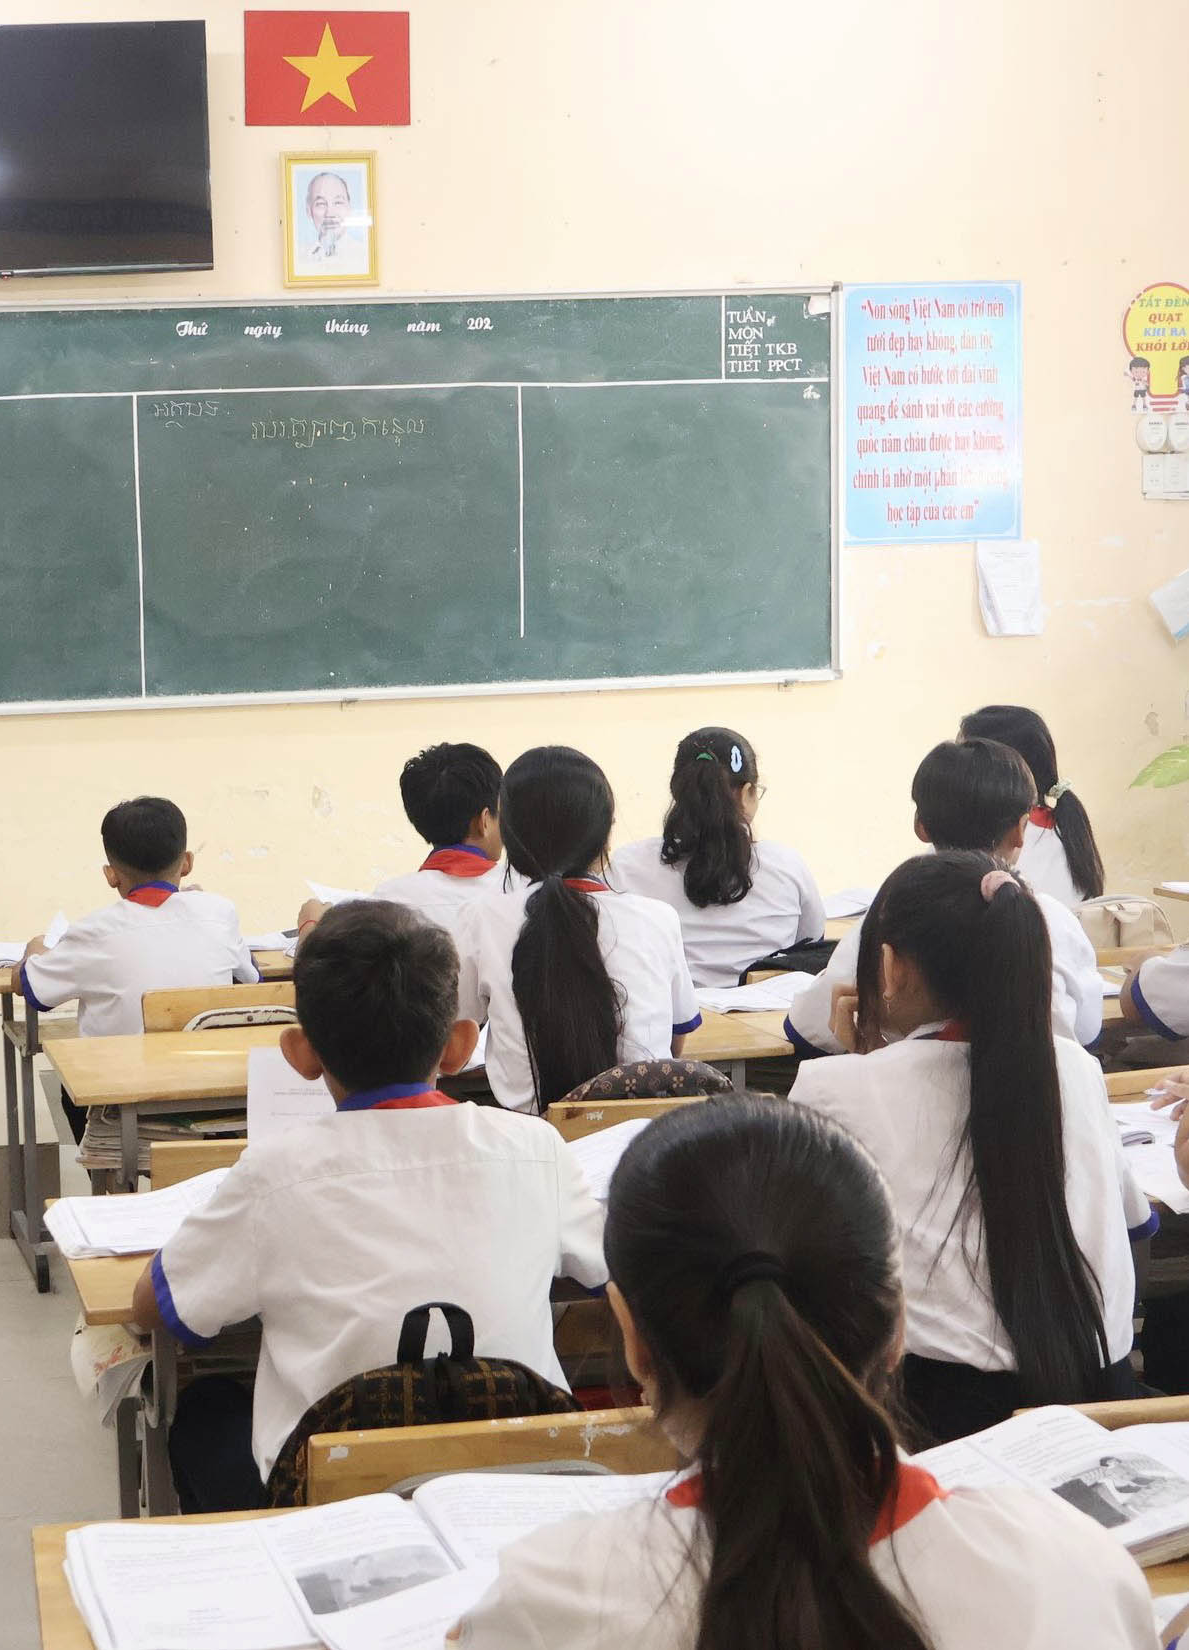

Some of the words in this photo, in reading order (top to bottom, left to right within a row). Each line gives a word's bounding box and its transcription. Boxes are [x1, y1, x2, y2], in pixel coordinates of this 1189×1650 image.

[727, 305, 766, 323] TUẦN
[913, 298, 931, 325] Việt
[935, 299, 956, 318] Nam
[958, 298, 969, 317] có
[1148, 313, 1183, 325] QUẠT
[175, 320, 208, 336] Thứ
[244, 321, 282, 339] ngày
[325, 319, 370, 337] tháng
[467, 317, 494, 330] 202
[728, 325, 764, 340] MÔN
[1144, 327, 1166, 336] KHI
[1171, 327, 1187, 336] RA
[728, 338, 761, 356] TIẾT
[765, 343, 798, 355] TKB
[889, 331, 905, 358] đẹp
[908, 331, 924, 356] hay
[767, 358, 803, 372] PPCT
[863, 366, 881, 392] Việt
[885, 366, 905, 386] Nam
[908, 364, 919, 385] có
[857, 403, 885, 425] quang
[902, 398, 923, 419] sánh
[926, 398, 939, 418] vai
[857, 428, 879, 459] quốc
[929, 431, 953, 458] được
[853, 466, 879, 488] chính
[883, 466, 891, 488] là
[914, 466, 931, 494] một
[887, 501, 903, 528] học
[906, 500, 920, 527] tập
[923, 498, 939, 521] của
[942, 501, 957, 521] các
